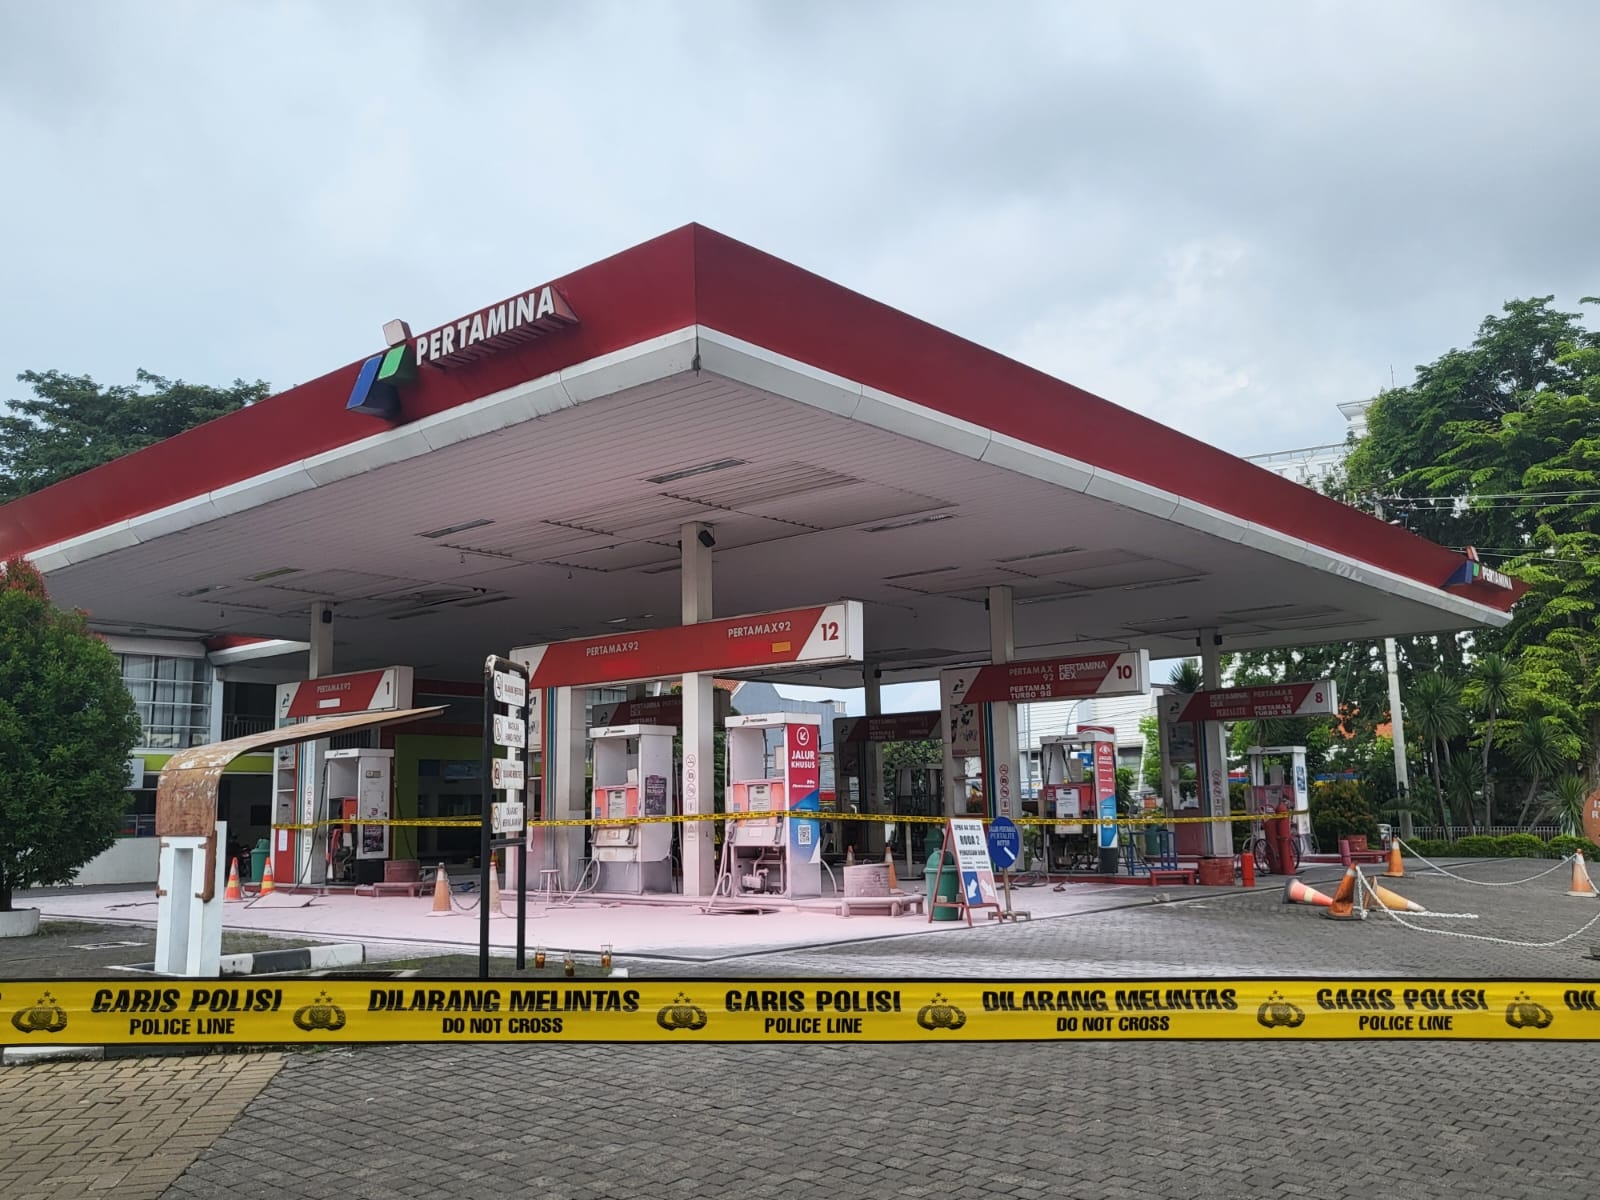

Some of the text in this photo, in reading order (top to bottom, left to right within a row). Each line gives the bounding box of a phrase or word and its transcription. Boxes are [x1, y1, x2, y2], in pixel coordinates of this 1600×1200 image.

[416, 286, 555, 366] PERTAMINA
[821, 622, 839, 641] 12
[1008, 665, 1053, 676] PERTAMAX
[1058, 660, 1107, 673] PERTAMINA
[1116, 665, 1133, 680] 10
[1059, 671, 1077, 681] DEX
[385, 681, 390, 695] 1
[1009, 684, 1052, 693] PERTAMAX
[1010, 689, 1052, 700] TURBO 98
[1314, 692, 1323, 703] 8
[791, 750, 815, 760] JALUR
[791, 761, 815, 769] KHUSUS
[959, 834, 981, 845] RODA 2
[91, 989, 283, 1013] GARIS POLISI
[368, 989, 640, 1012] DILARANG MELINTAS
[725, 990, 901, 1012] GARIS POLISI
[982, 988, 1238, 1011] DILARANG MELINTAS
[1316, 988, 1488, 1010] GARIS POLISI
[129, 1018, 235, 1035] POLICE LINE
[442, 1018, 563, 1033] DO NOT CROSS
[764, 1018, 863, 1033] POLICE LINE
[1056, 1016, 1170, 1032] DO NOT CROSS
[1359, 1015, 1453, 1031] POLICE LINE
